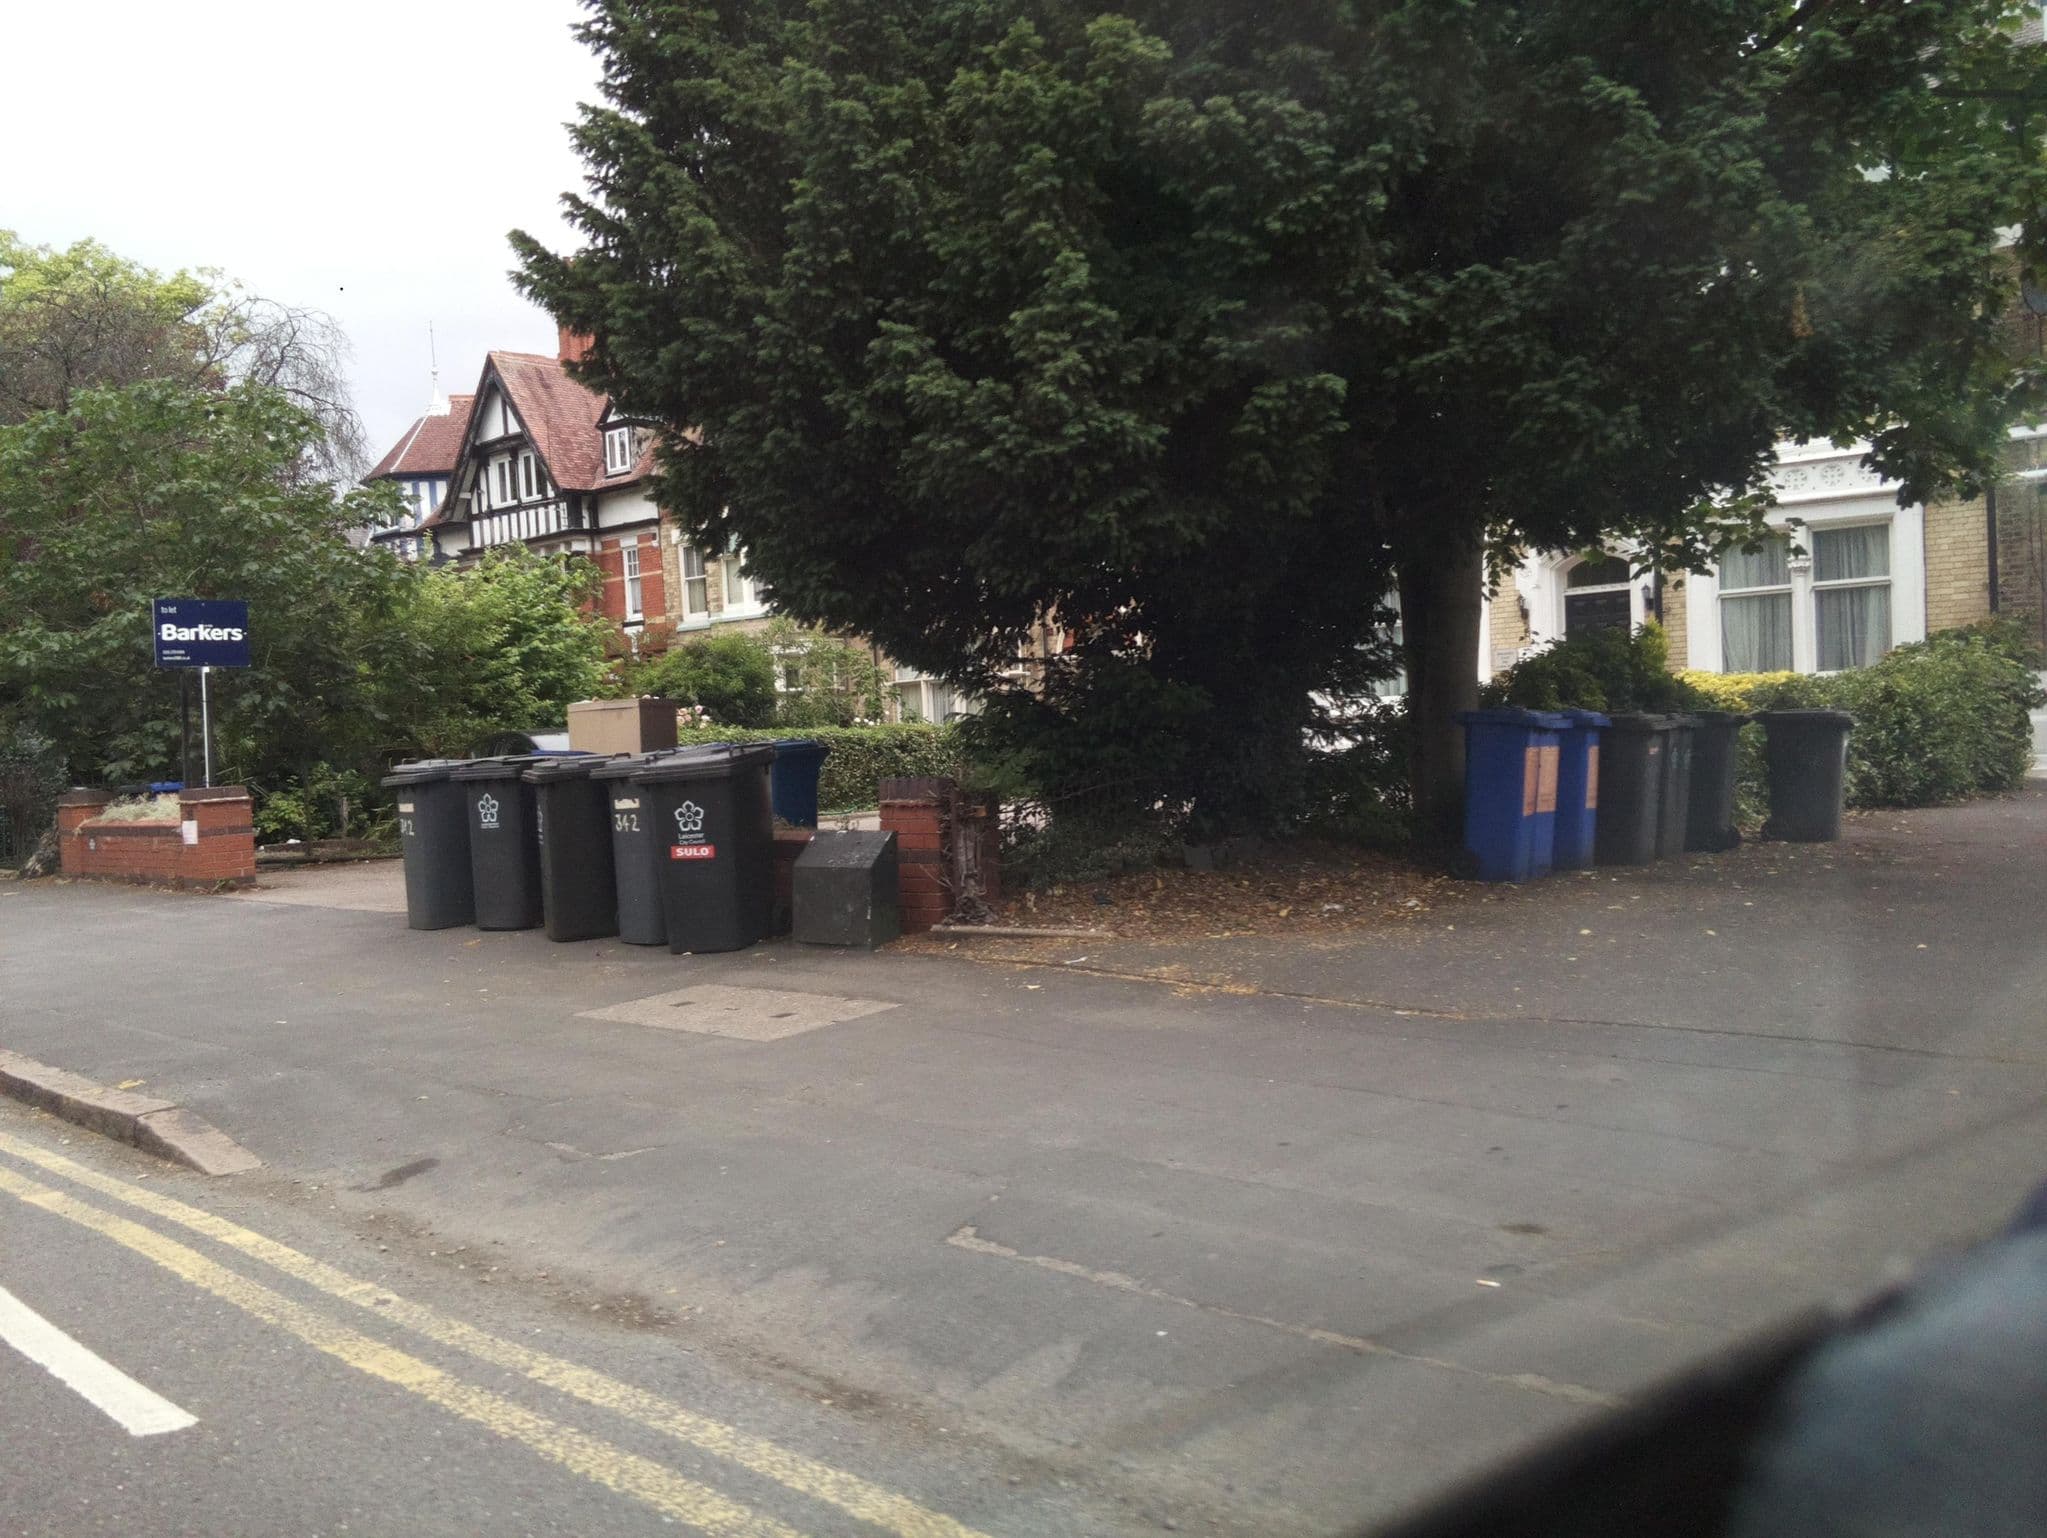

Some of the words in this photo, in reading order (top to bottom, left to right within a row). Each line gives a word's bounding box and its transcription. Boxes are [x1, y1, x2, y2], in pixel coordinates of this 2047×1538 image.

[160, 606, 168, 614] to
[168, 605, 177, 614] let
[161, 623, 243, 641] Barkers
[614, 813, 641, 833] 342
[678, 832, 705, 840] Leicester
[675, 847, 709, 857] SULO
